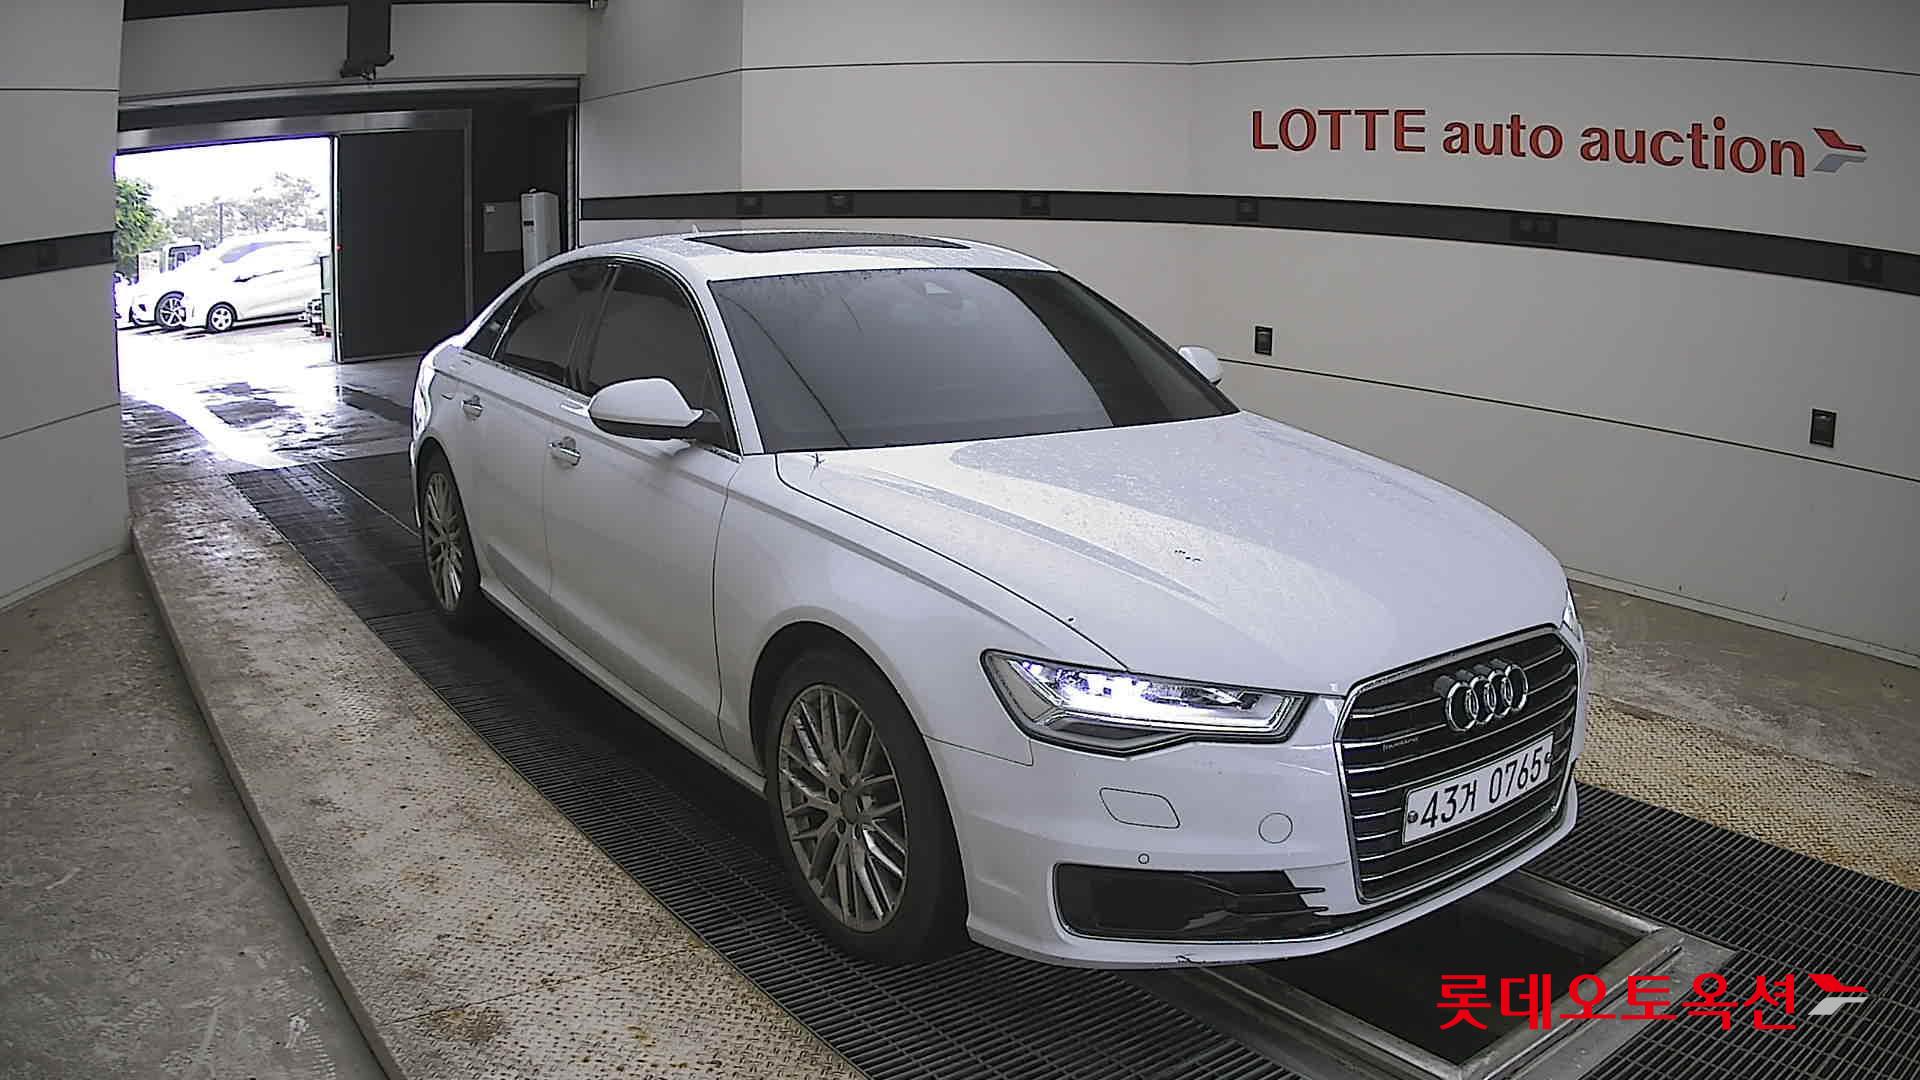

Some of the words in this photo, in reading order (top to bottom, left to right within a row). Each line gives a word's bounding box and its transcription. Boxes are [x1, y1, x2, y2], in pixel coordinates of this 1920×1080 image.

[1252, 109, 1426, 153] LOTTE
[1443, 115, 1564, 158] auto
[1580, 116, 1807, 177] auction
[1420, 779, 1478, 828] 43거
[1489, 747, 1543, 804] 0765
